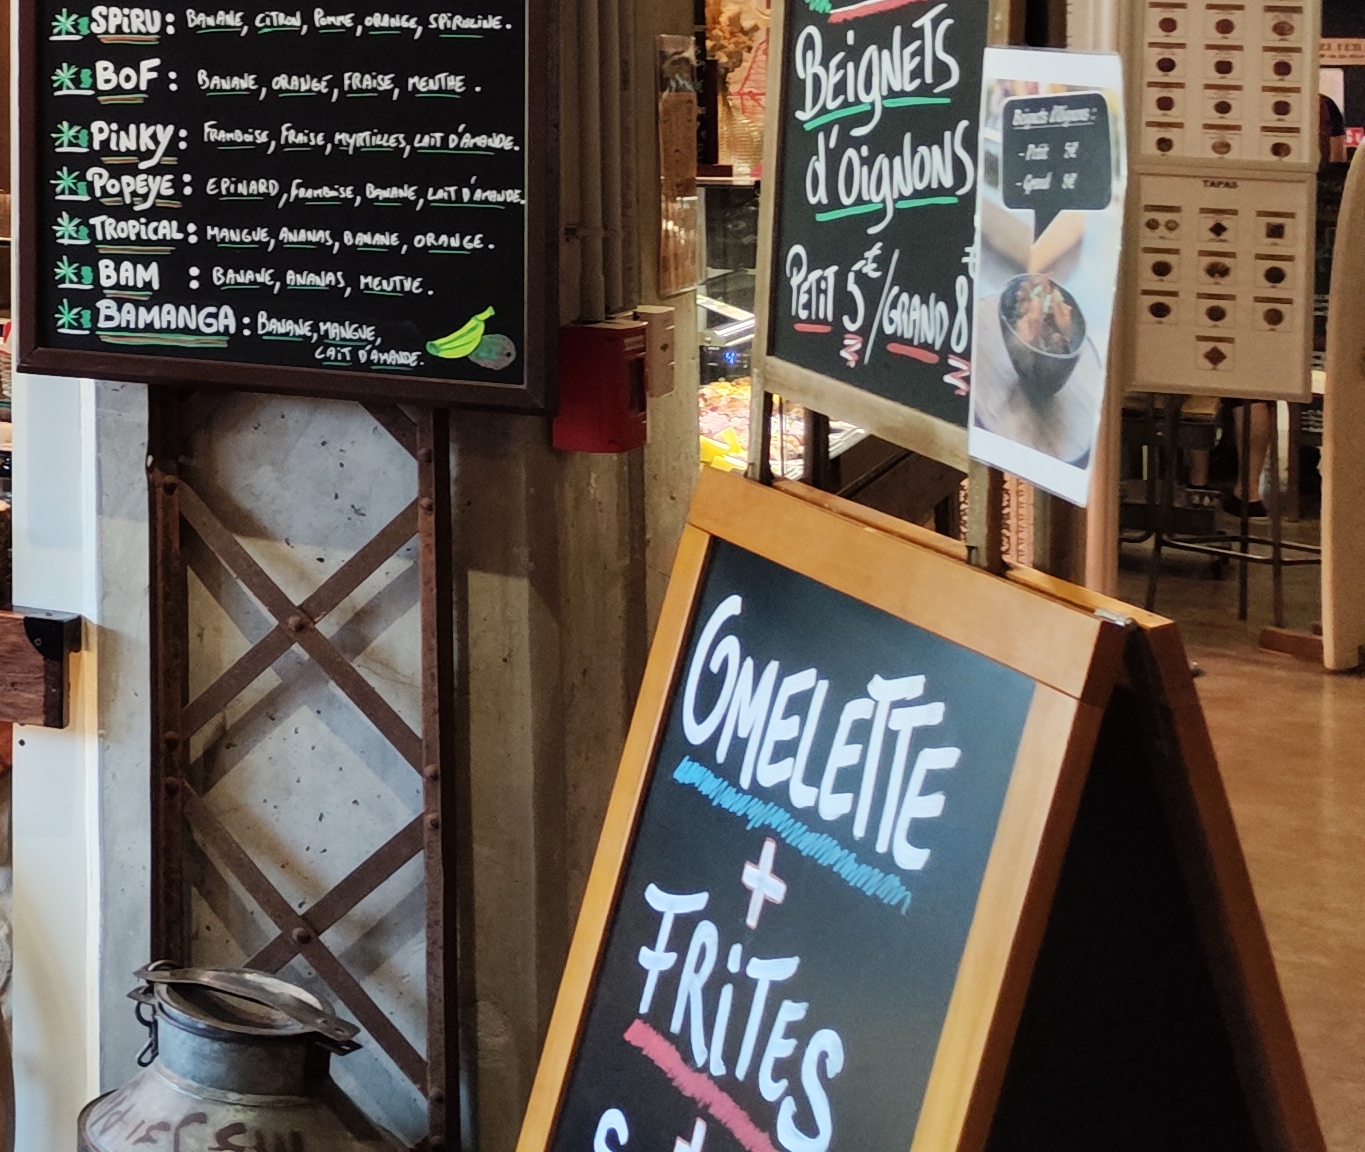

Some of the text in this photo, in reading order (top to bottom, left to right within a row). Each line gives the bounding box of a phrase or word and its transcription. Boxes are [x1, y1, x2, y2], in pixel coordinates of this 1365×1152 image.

[413, 130, 445, 151] LAIT
[426, 184, 458, 203] LAIT
[315, 343, 353, 362] LAIT
[681, 594, 962, 871] OMELETTE
[637, 882, 845, 1152] FRITES
